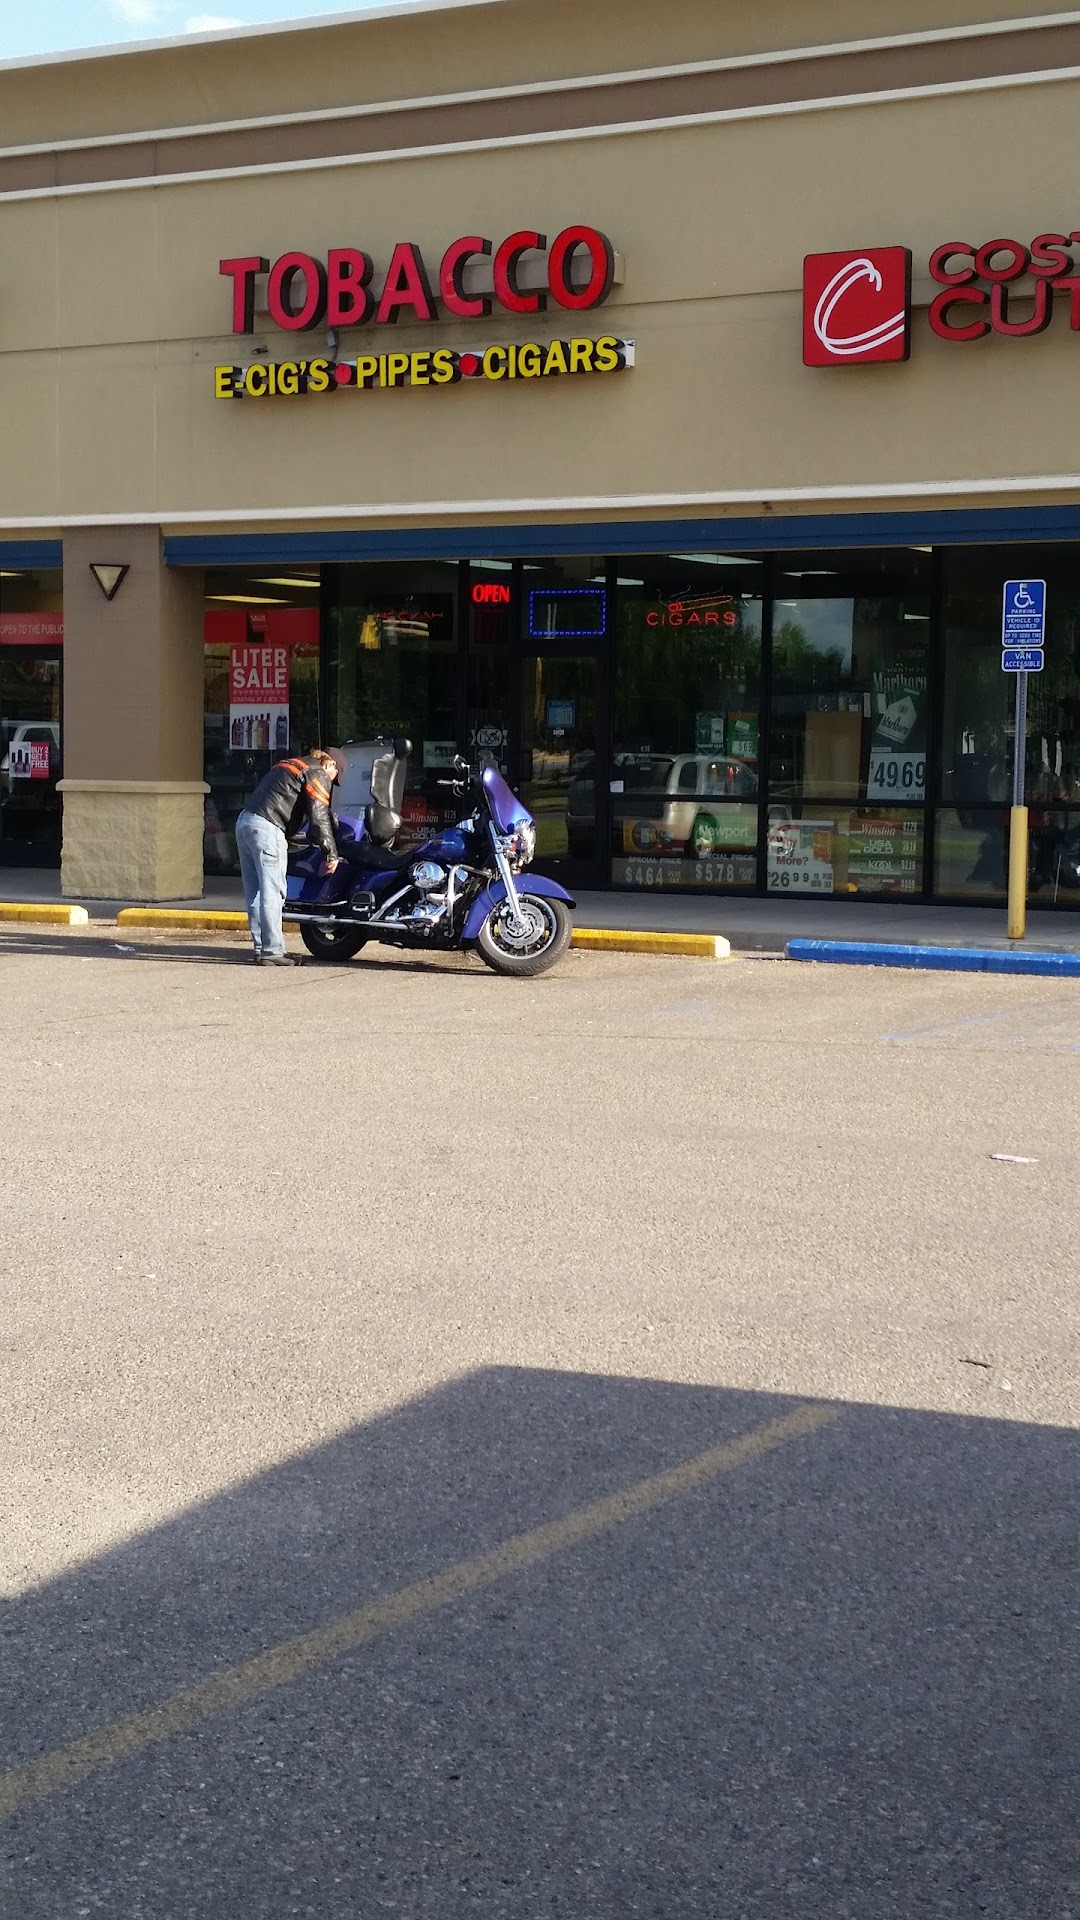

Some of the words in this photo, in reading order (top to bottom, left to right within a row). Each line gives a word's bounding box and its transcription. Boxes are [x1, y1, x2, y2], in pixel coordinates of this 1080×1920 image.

[219, 225, 614, 335] TOBACCO
[215, 359, 335, 399] E-CIG'S
[357, 348, 459, 389] PIPES
[482, 335, 624, 381] CIGARS
[472, 584, 510, 603] OPEN
[646, 611, 737, 626] CIGARS
[18, 623, 27, 635] TO
[28, 623, 41, 635] THE
[232, 648, 287, 667] LITER
[1015, 652, 1032, 660] VAN
[232, 667, 287, 689] SALE
[873, 672, 927, 692] Marlboro
[44, 746, 49, 754] 2
[31, 760, 49, 768] FREE
[410, 812, 439, 823] Winston
[698, 824, 750, 838] Newport
[861, 823, 896, 836] Winston
[869, 839, 892, 847] USA
[628, 856, 658, 864] SPECIAL
[659, 857, 681, 865] PRICE
[776, 857, 808, 866] More?
[868, 859, 894, 871] KOOL
